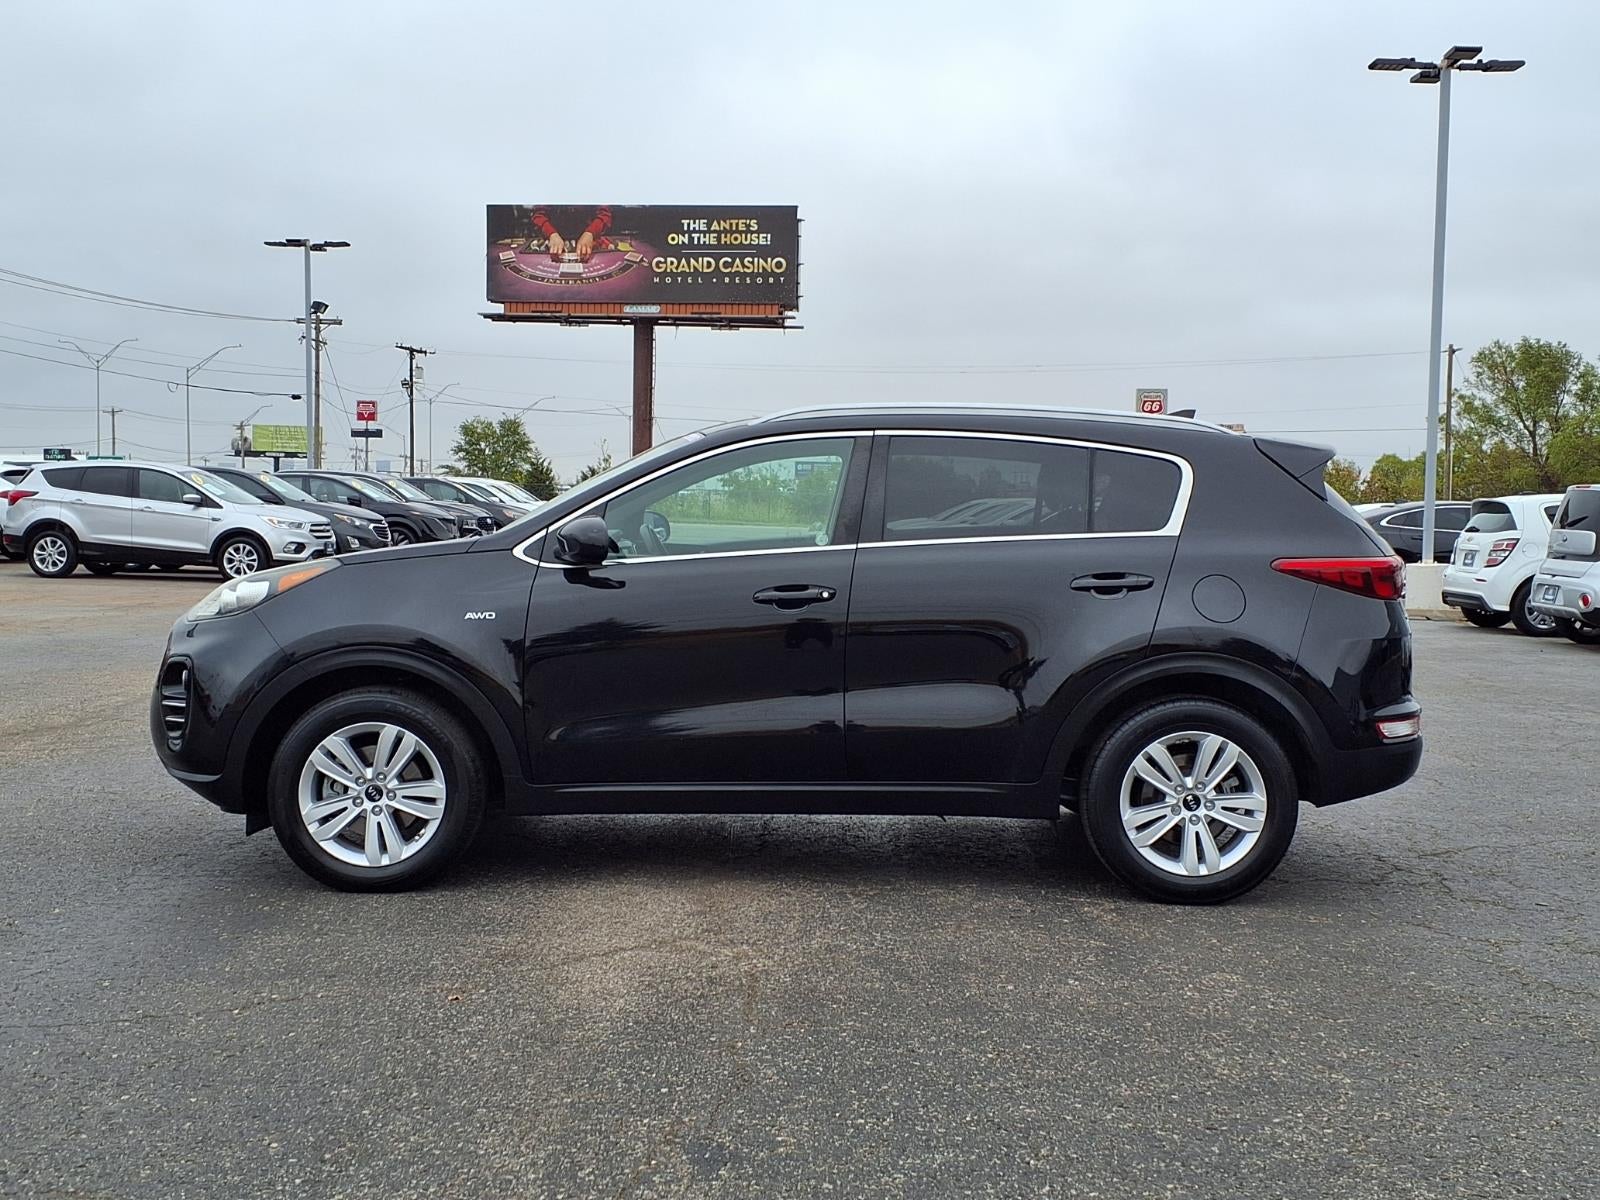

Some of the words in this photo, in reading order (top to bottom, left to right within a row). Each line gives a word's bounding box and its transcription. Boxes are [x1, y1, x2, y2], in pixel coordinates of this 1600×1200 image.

[681, 219, 708, 231] THE
[710, 219, 758, 231] ANTE'S
[667, 233, 689, 245] ON
[691, 233, 718, 245] THE
[720, 233, 771, 245] HOUSE!
[652, 257, 716, 273] GRAND
[718, 257, 787, 273] CASINO
[653, 276, 703, 284] HOTEL
[724, 276, 785, 284] RESORT
[1143, 401, 1161, 412] 66
[464, 611, 496, 620] AWD
